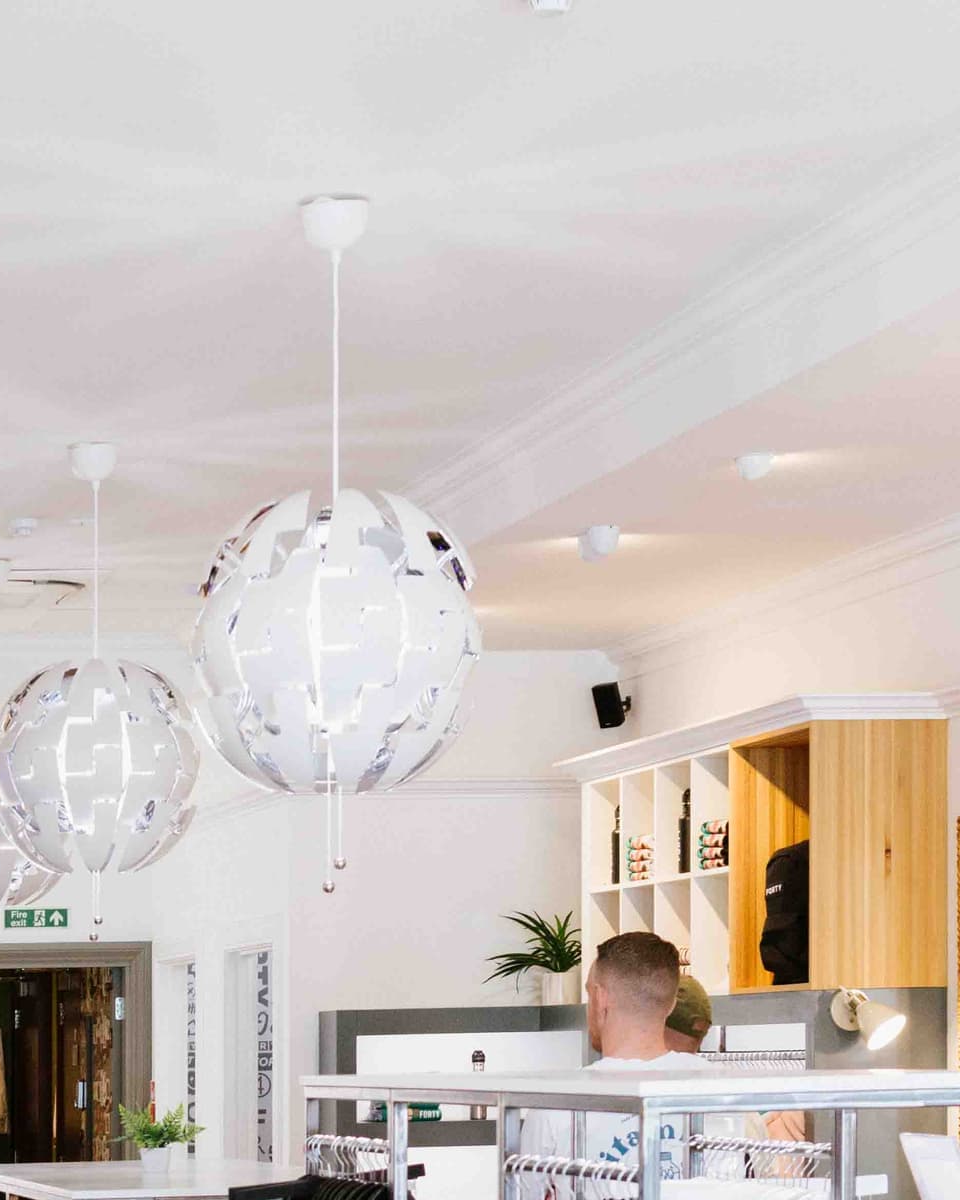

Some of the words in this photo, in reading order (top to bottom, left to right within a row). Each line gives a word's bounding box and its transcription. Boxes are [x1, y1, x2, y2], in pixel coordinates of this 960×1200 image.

[11, 911, 28, 919] Fire
[10, 919, 27, 927] exit
[419, 1110, 441, 1119] FORTY
